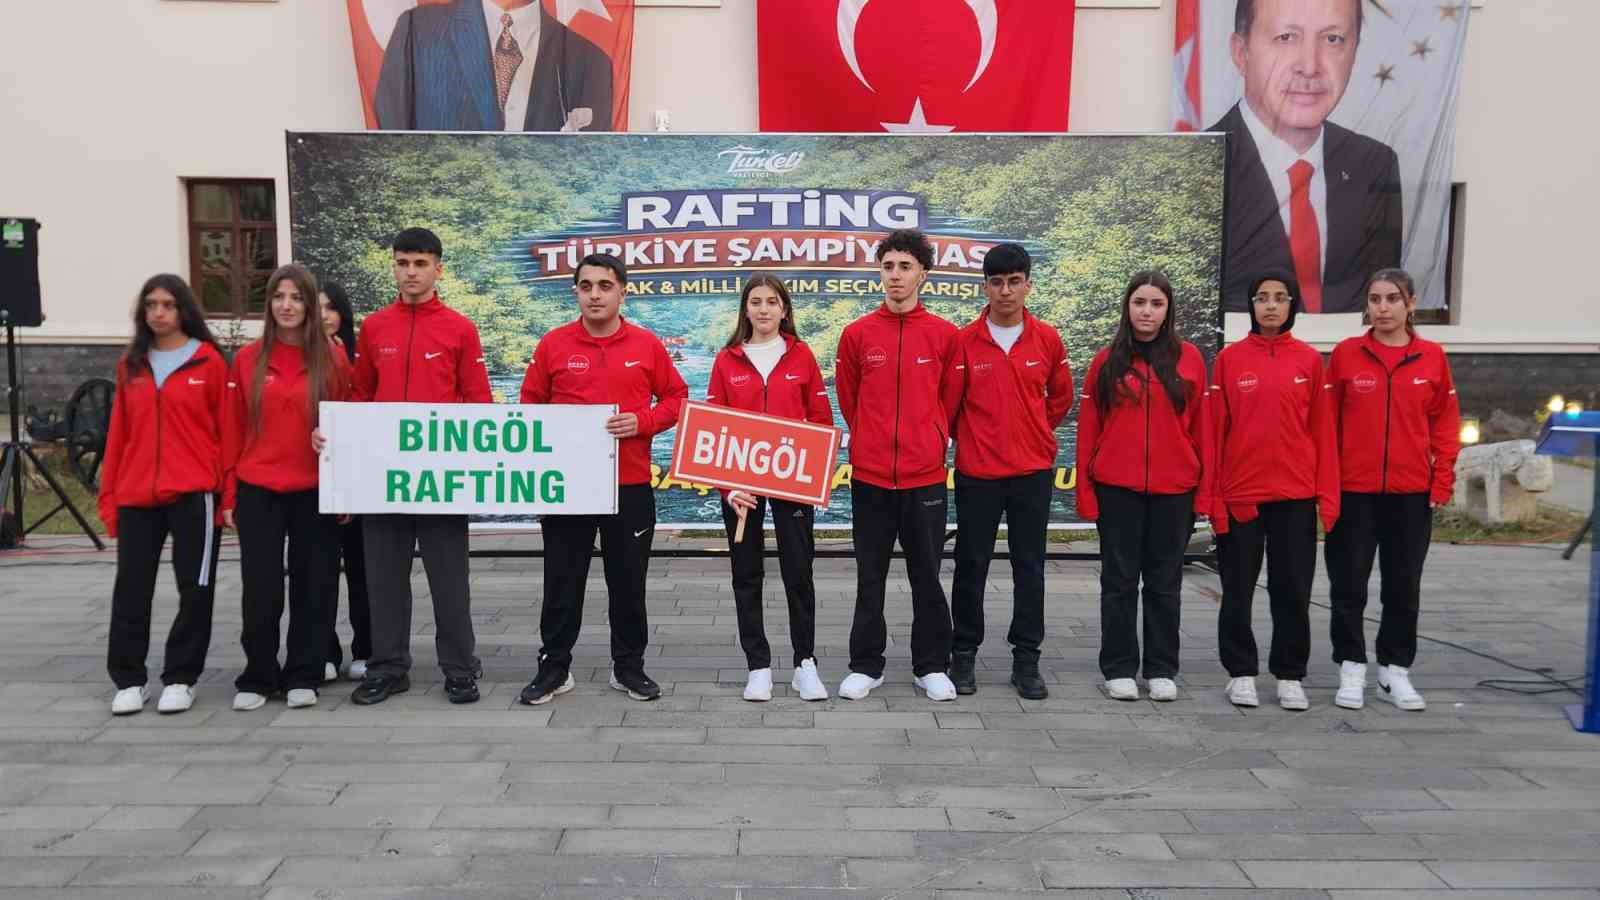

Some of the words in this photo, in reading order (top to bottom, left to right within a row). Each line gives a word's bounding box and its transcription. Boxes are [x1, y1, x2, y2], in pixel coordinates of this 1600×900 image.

[660, 280, 675, 294] &
[680, 276, 741, 294] MİLLİ
[919, 281, 980, 300] ARIŞI
[399, 411, 552, 453] BİNGÖL
[692, 425, 813, 484] BİNGÖL
[386, 462, 565, 504] RAFTİNG
